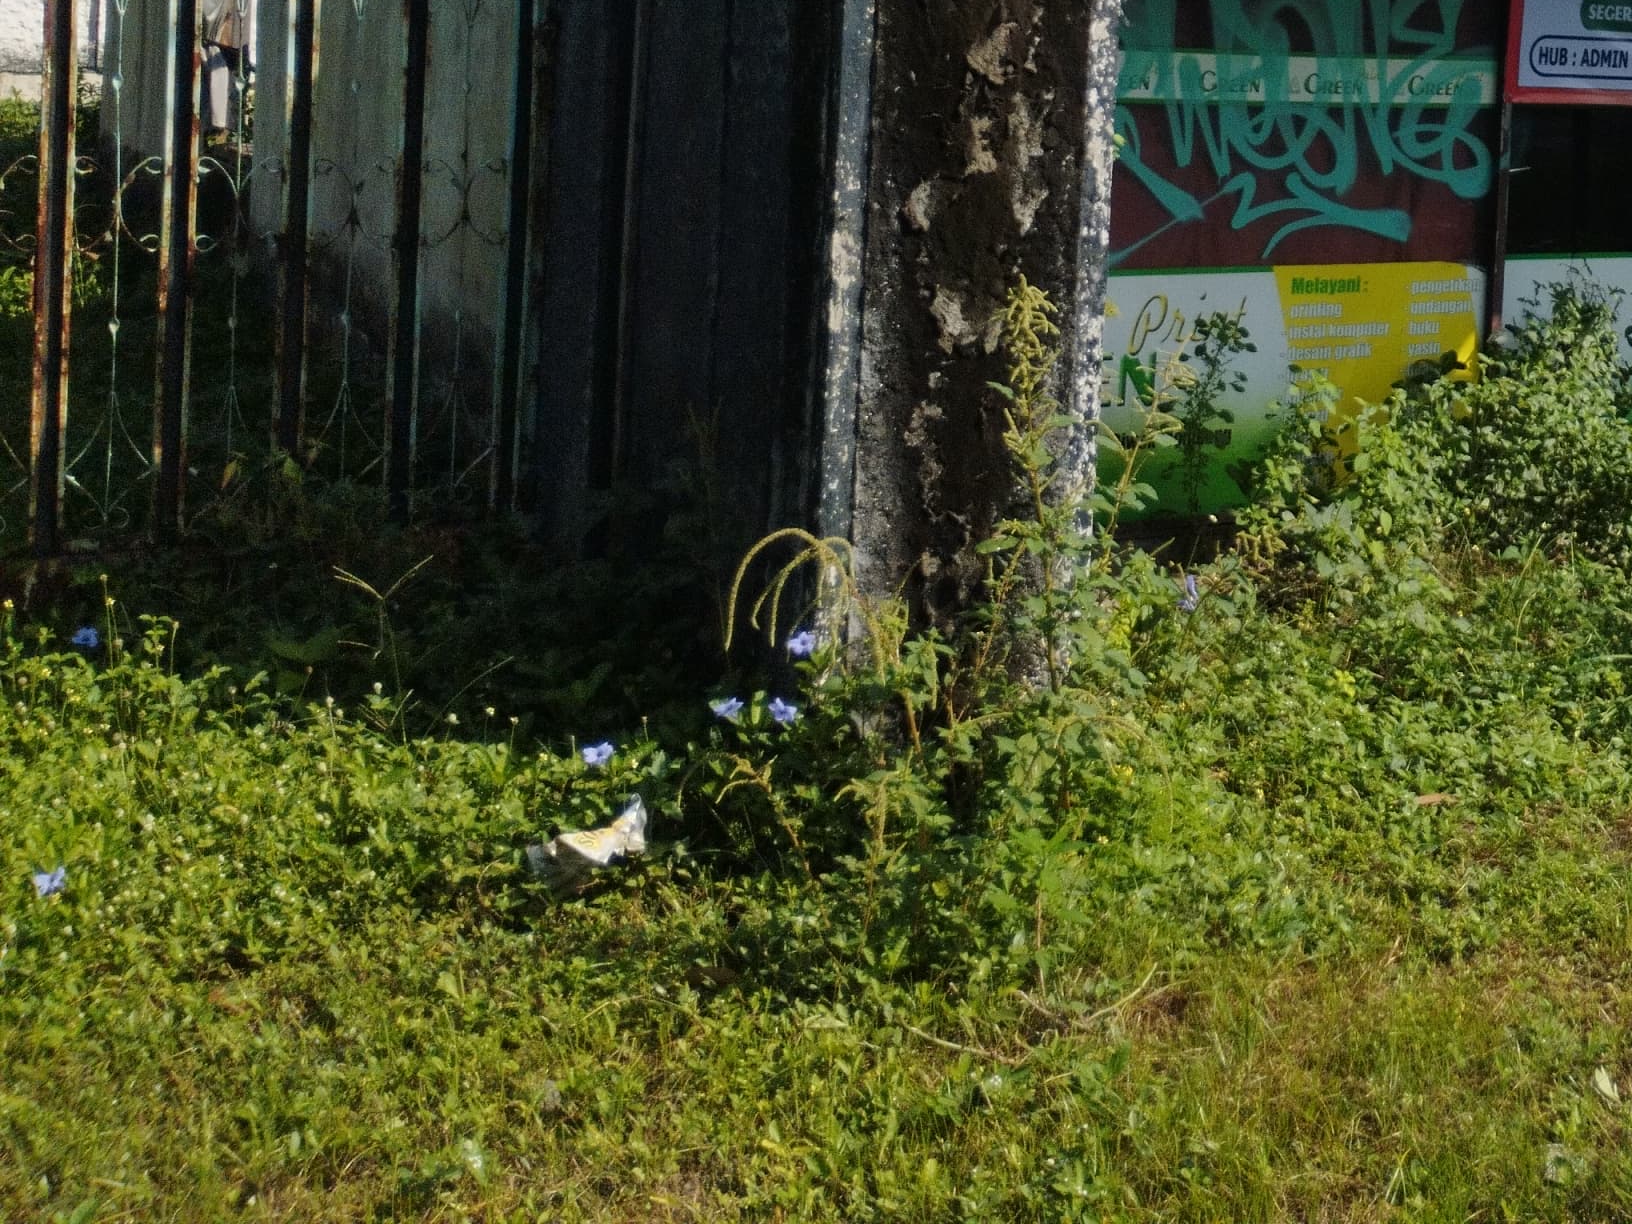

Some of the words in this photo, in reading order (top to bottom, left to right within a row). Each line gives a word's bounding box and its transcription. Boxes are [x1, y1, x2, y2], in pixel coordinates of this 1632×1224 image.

[1538, 47, 1568, 67] HUB
[1580, 50, 1628, 69] ADMIN
[1291, 276, 1361, 295] Melayani
[1290, 302, 1343, 318] printing
[1128, 294, 1247, 356] Prit
[1328, 322, 1390, 338] komputer
[1408, 321, 1440, 335] buku
[1335, 342, 1373, 360] grafik
